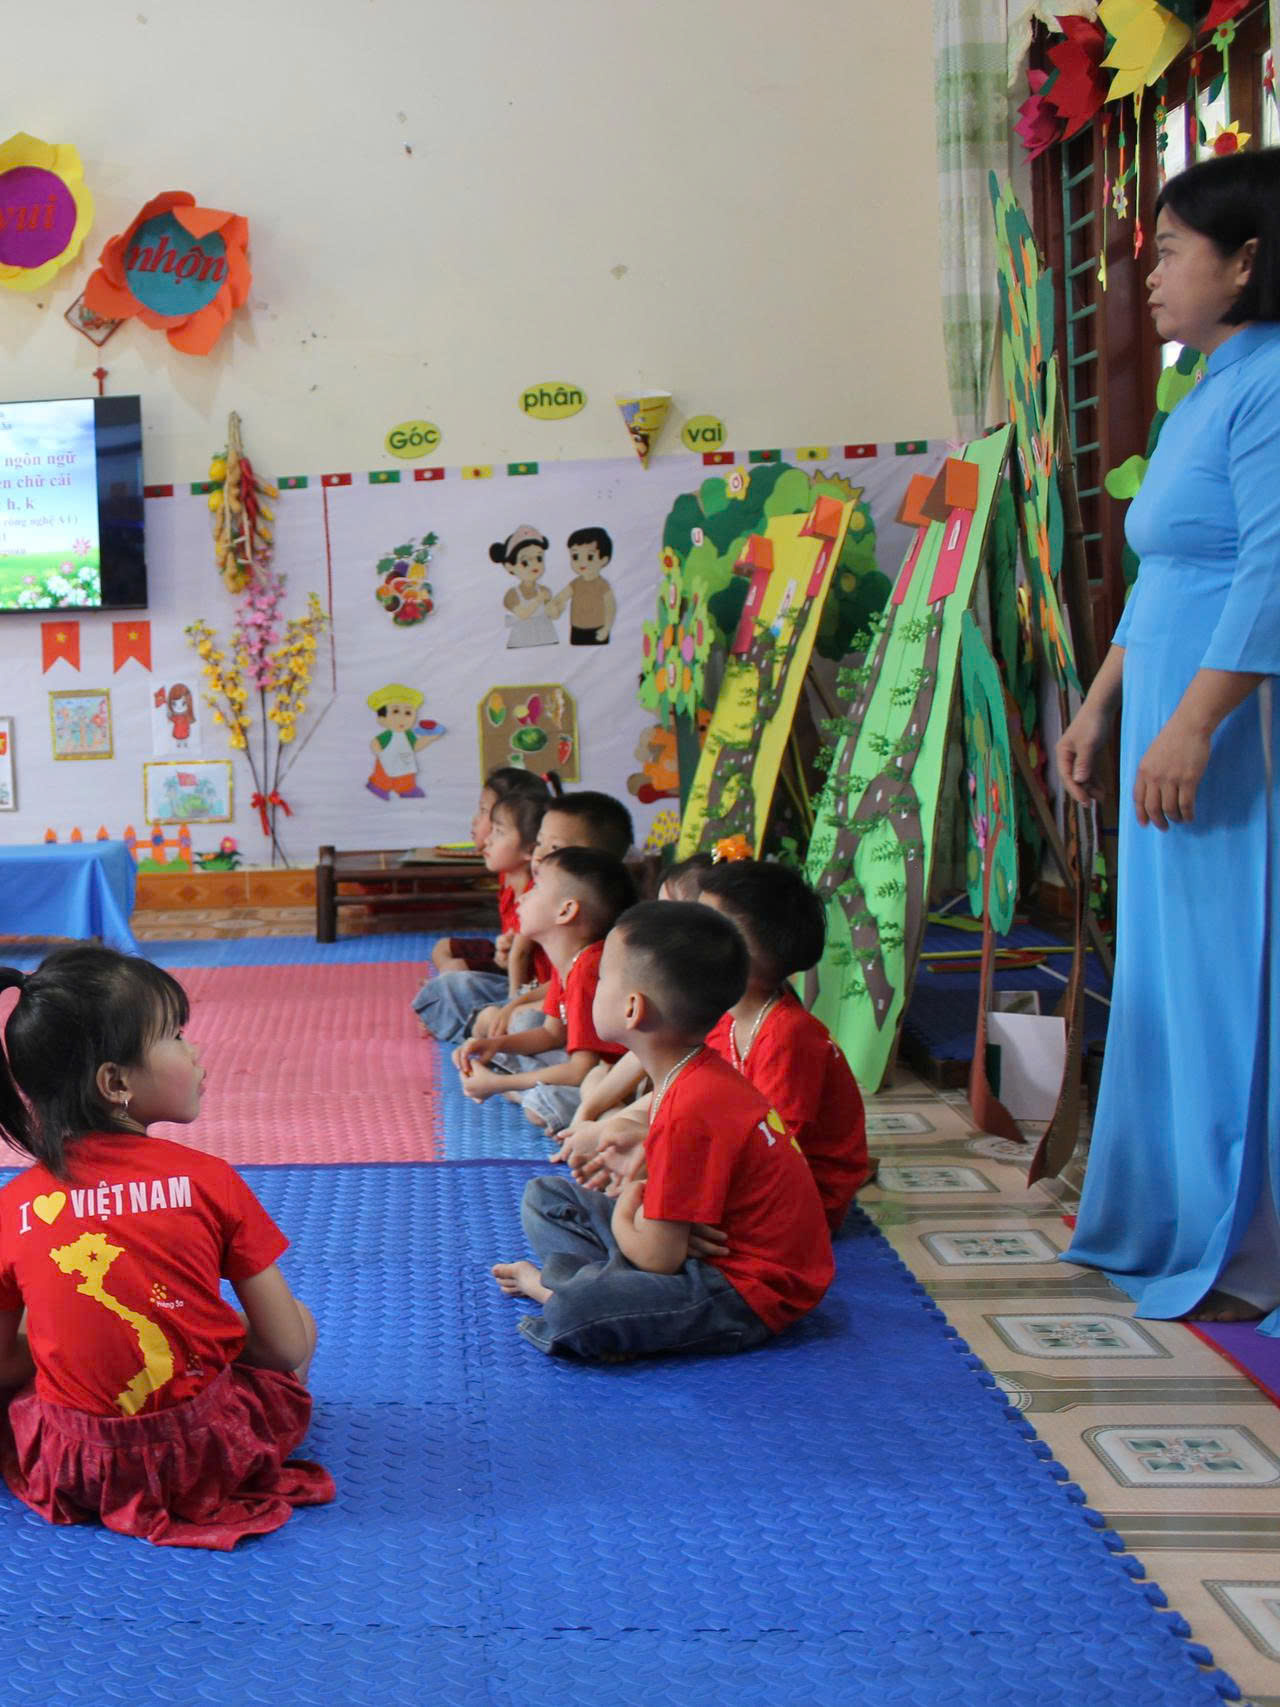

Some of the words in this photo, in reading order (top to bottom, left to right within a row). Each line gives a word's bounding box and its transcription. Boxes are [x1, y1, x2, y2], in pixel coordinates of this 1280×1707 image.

[126, 236, 226, 285] nhộn
[388, 425, 438, 450] Góc
[523, 387, 584, 412] phân
[687, 423, 723, 444] vai
[5, 452, 42, 469] ngôn
[47, 450, 77, 468] ngữ
[49, 472, 72, 487] cái
[25, 496, 35, 510] k
[19, 1201, 32, 1235] I
[70, 1180, 125, 1221] VIỆT
[129, 1176, 193, 1214] NAM
